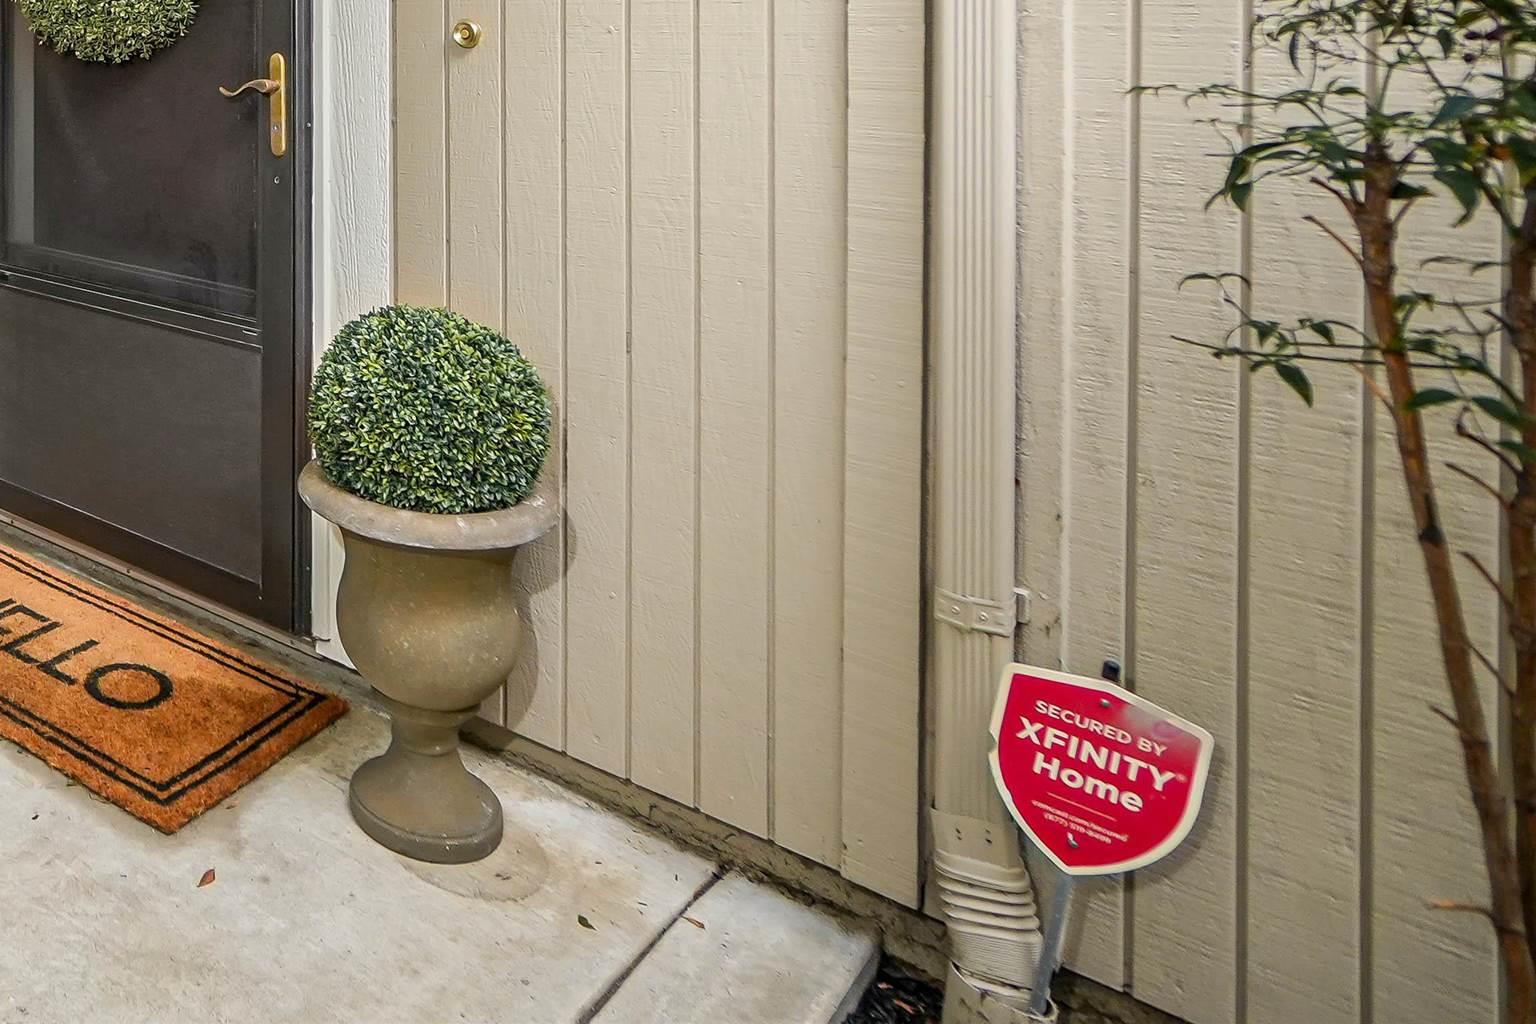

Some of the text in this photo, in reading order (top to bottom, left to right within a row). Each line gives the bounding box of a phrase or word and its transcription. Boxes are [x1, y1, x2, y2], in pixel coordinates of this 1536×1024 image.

[1016, 715, 1177, 792] XFINITY
[1035, 699, 1168, 757] SECURED BY
[1032, 751, 1144, 813] Home
